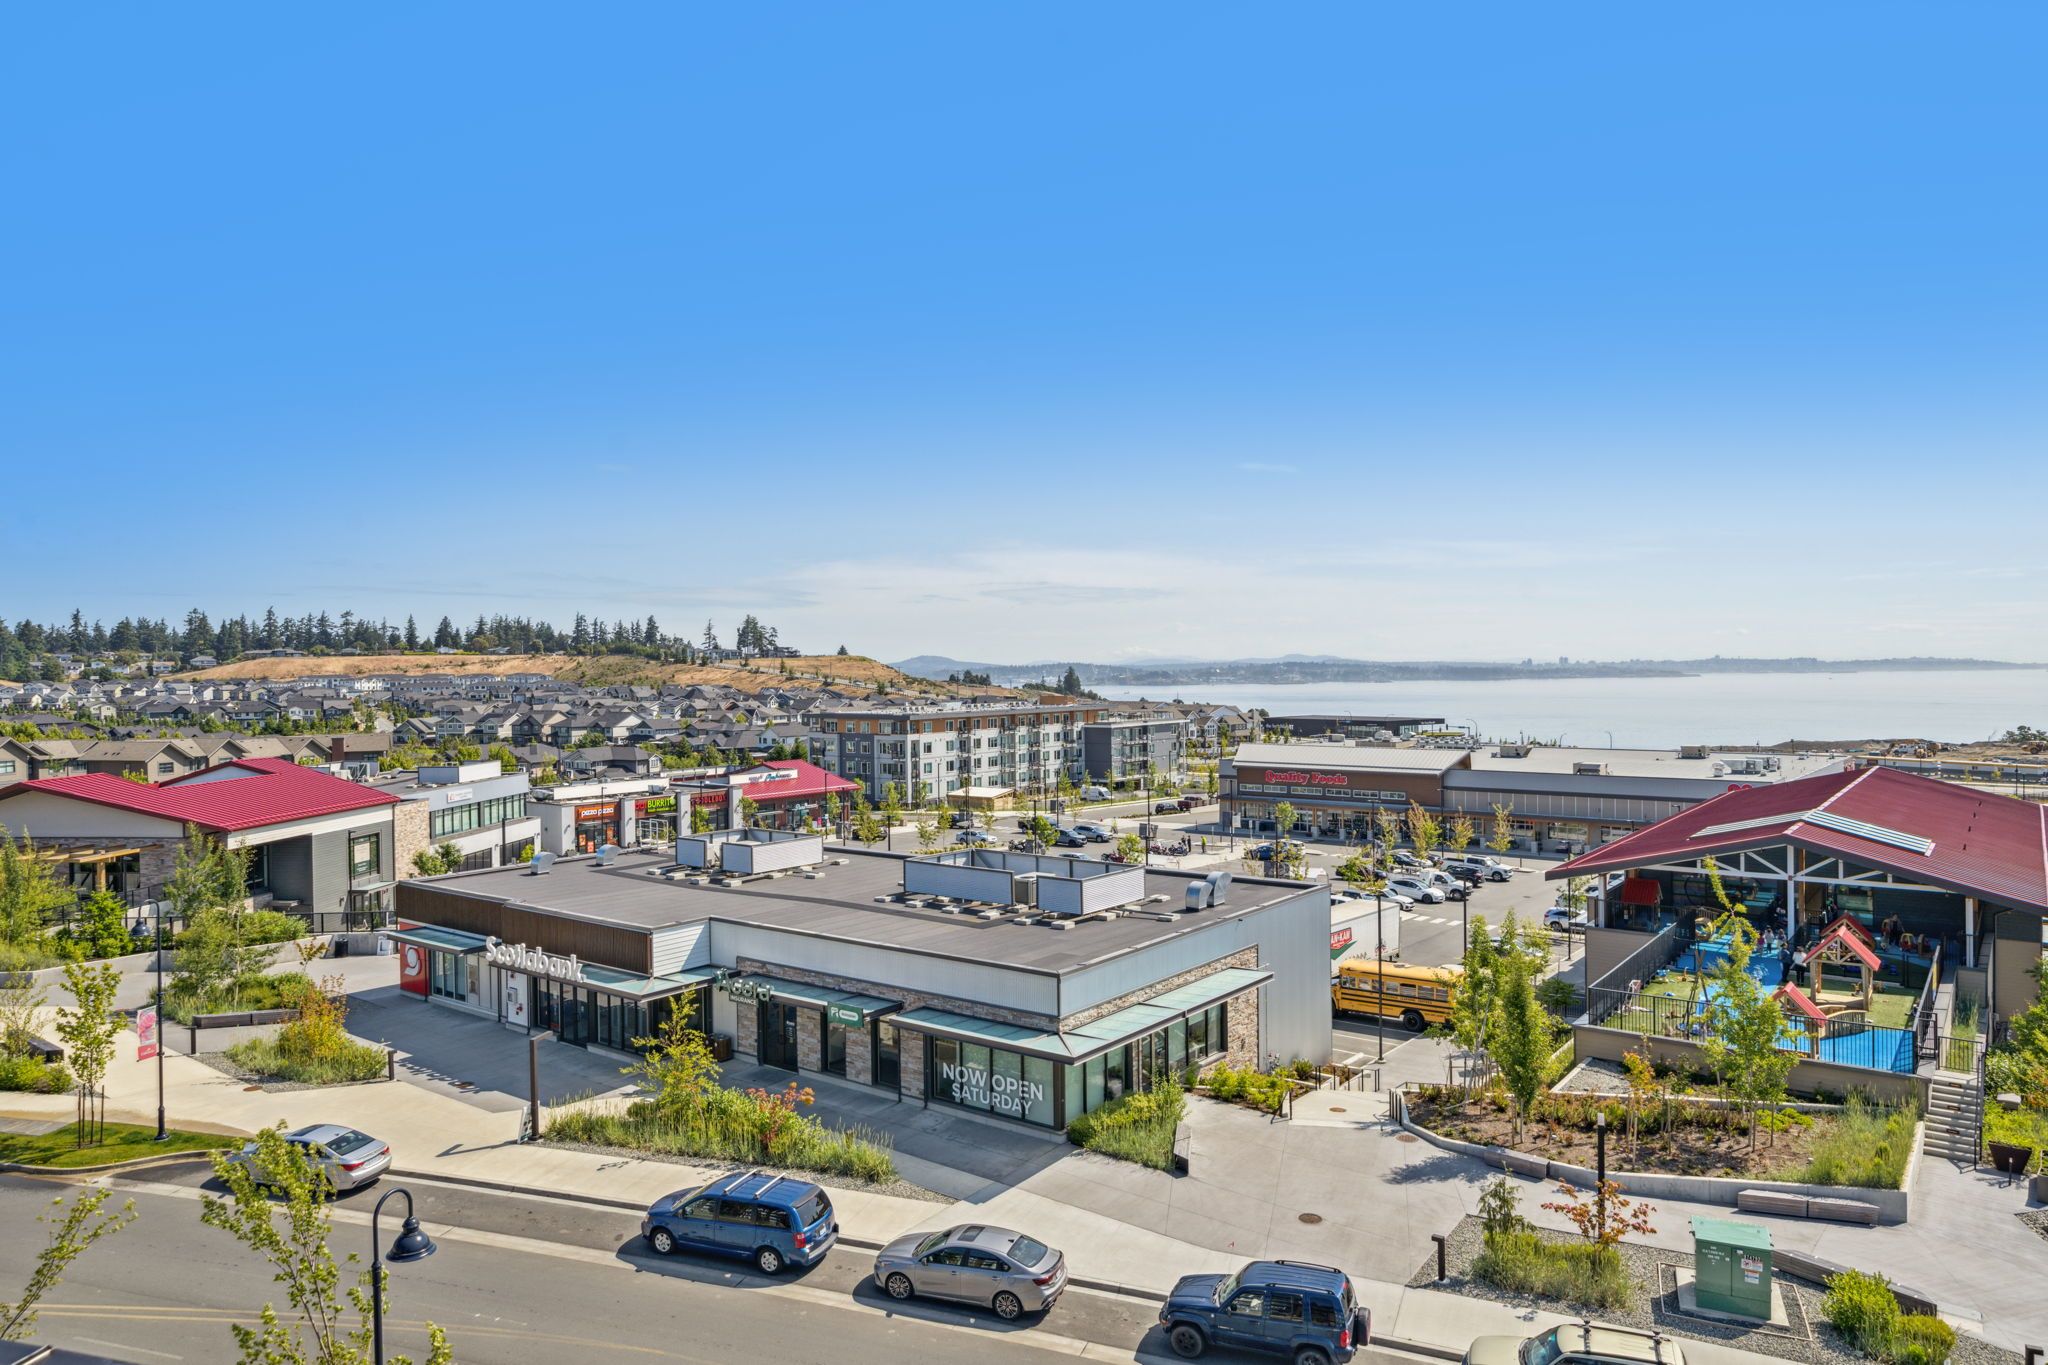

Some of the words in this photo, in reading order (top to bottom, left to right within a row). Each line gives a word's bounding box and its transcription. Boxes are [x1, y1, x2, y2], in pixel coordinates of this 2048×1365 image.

[1265, 770, 1309, 785] Quality
[1311, 772, 1347, 785] Foods
[581, 808, 597, 818] pizza
[598, 806, 614, 817] pizza
[486, 936, 583, 982] Scotiabank
[730, 995, 757, 1006] INSURANCE
[942, 1062, 987, 1088] NOW
[992, 1074, 1043, 1101] OPEN
[952, 1083, 1032, 1114] SATURDAY
